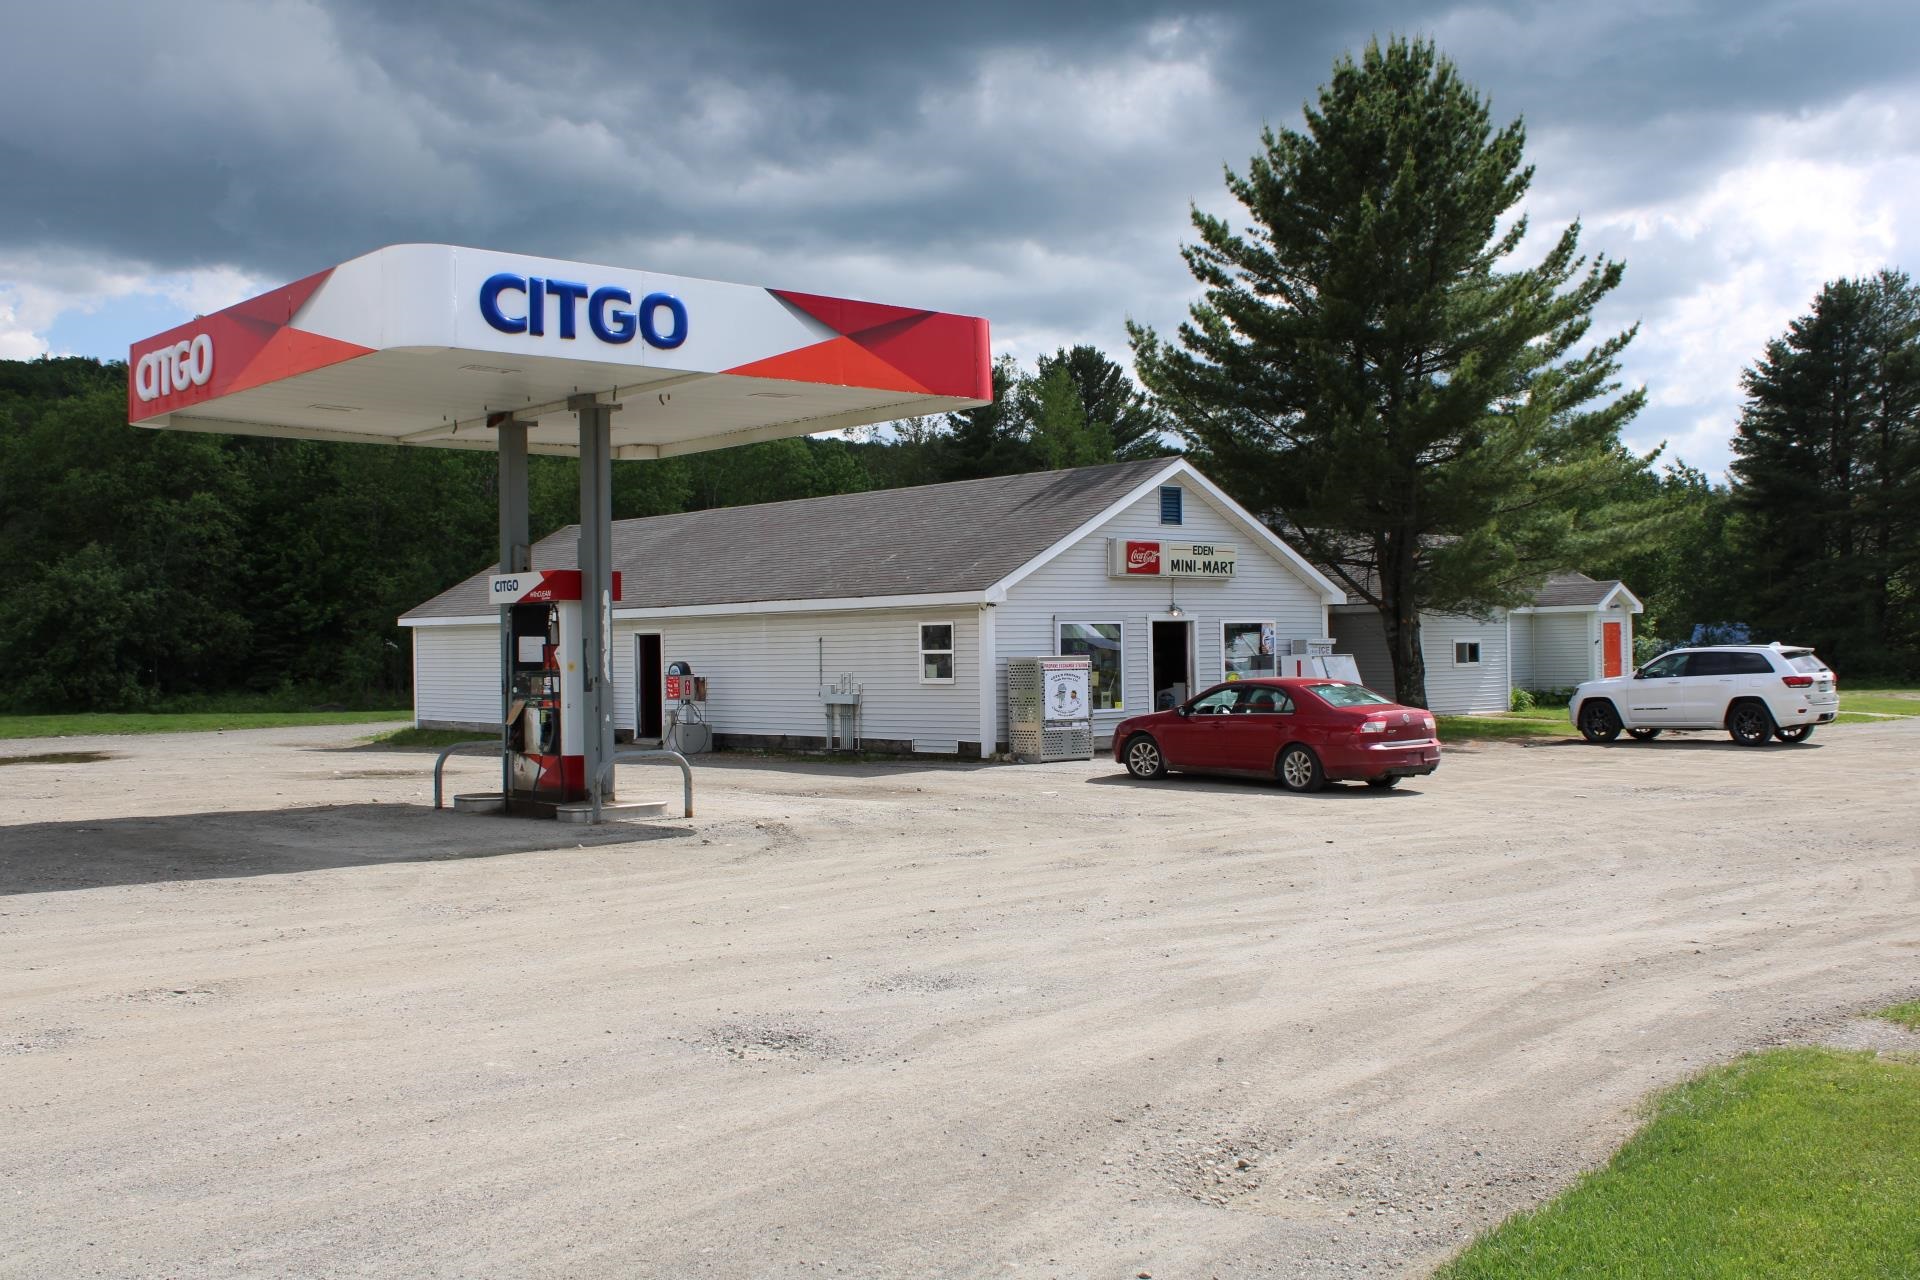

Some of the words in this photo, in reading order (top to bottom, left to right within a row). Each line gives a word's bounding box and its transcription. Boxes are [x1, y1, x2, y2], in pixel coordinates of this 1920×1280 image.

[479, 272, 689, 350] CITGO
[135, 333, 213, 402] CITGO
[1131, 549, 1159, 563] Coca-Cola
[1193, 545, 1214, 556] EDEN
[1170, 559, 1235, 574] MINI-MART
[495, 579, 519, 592] CITGO
[1318, 646, 1330, 655] ICE
